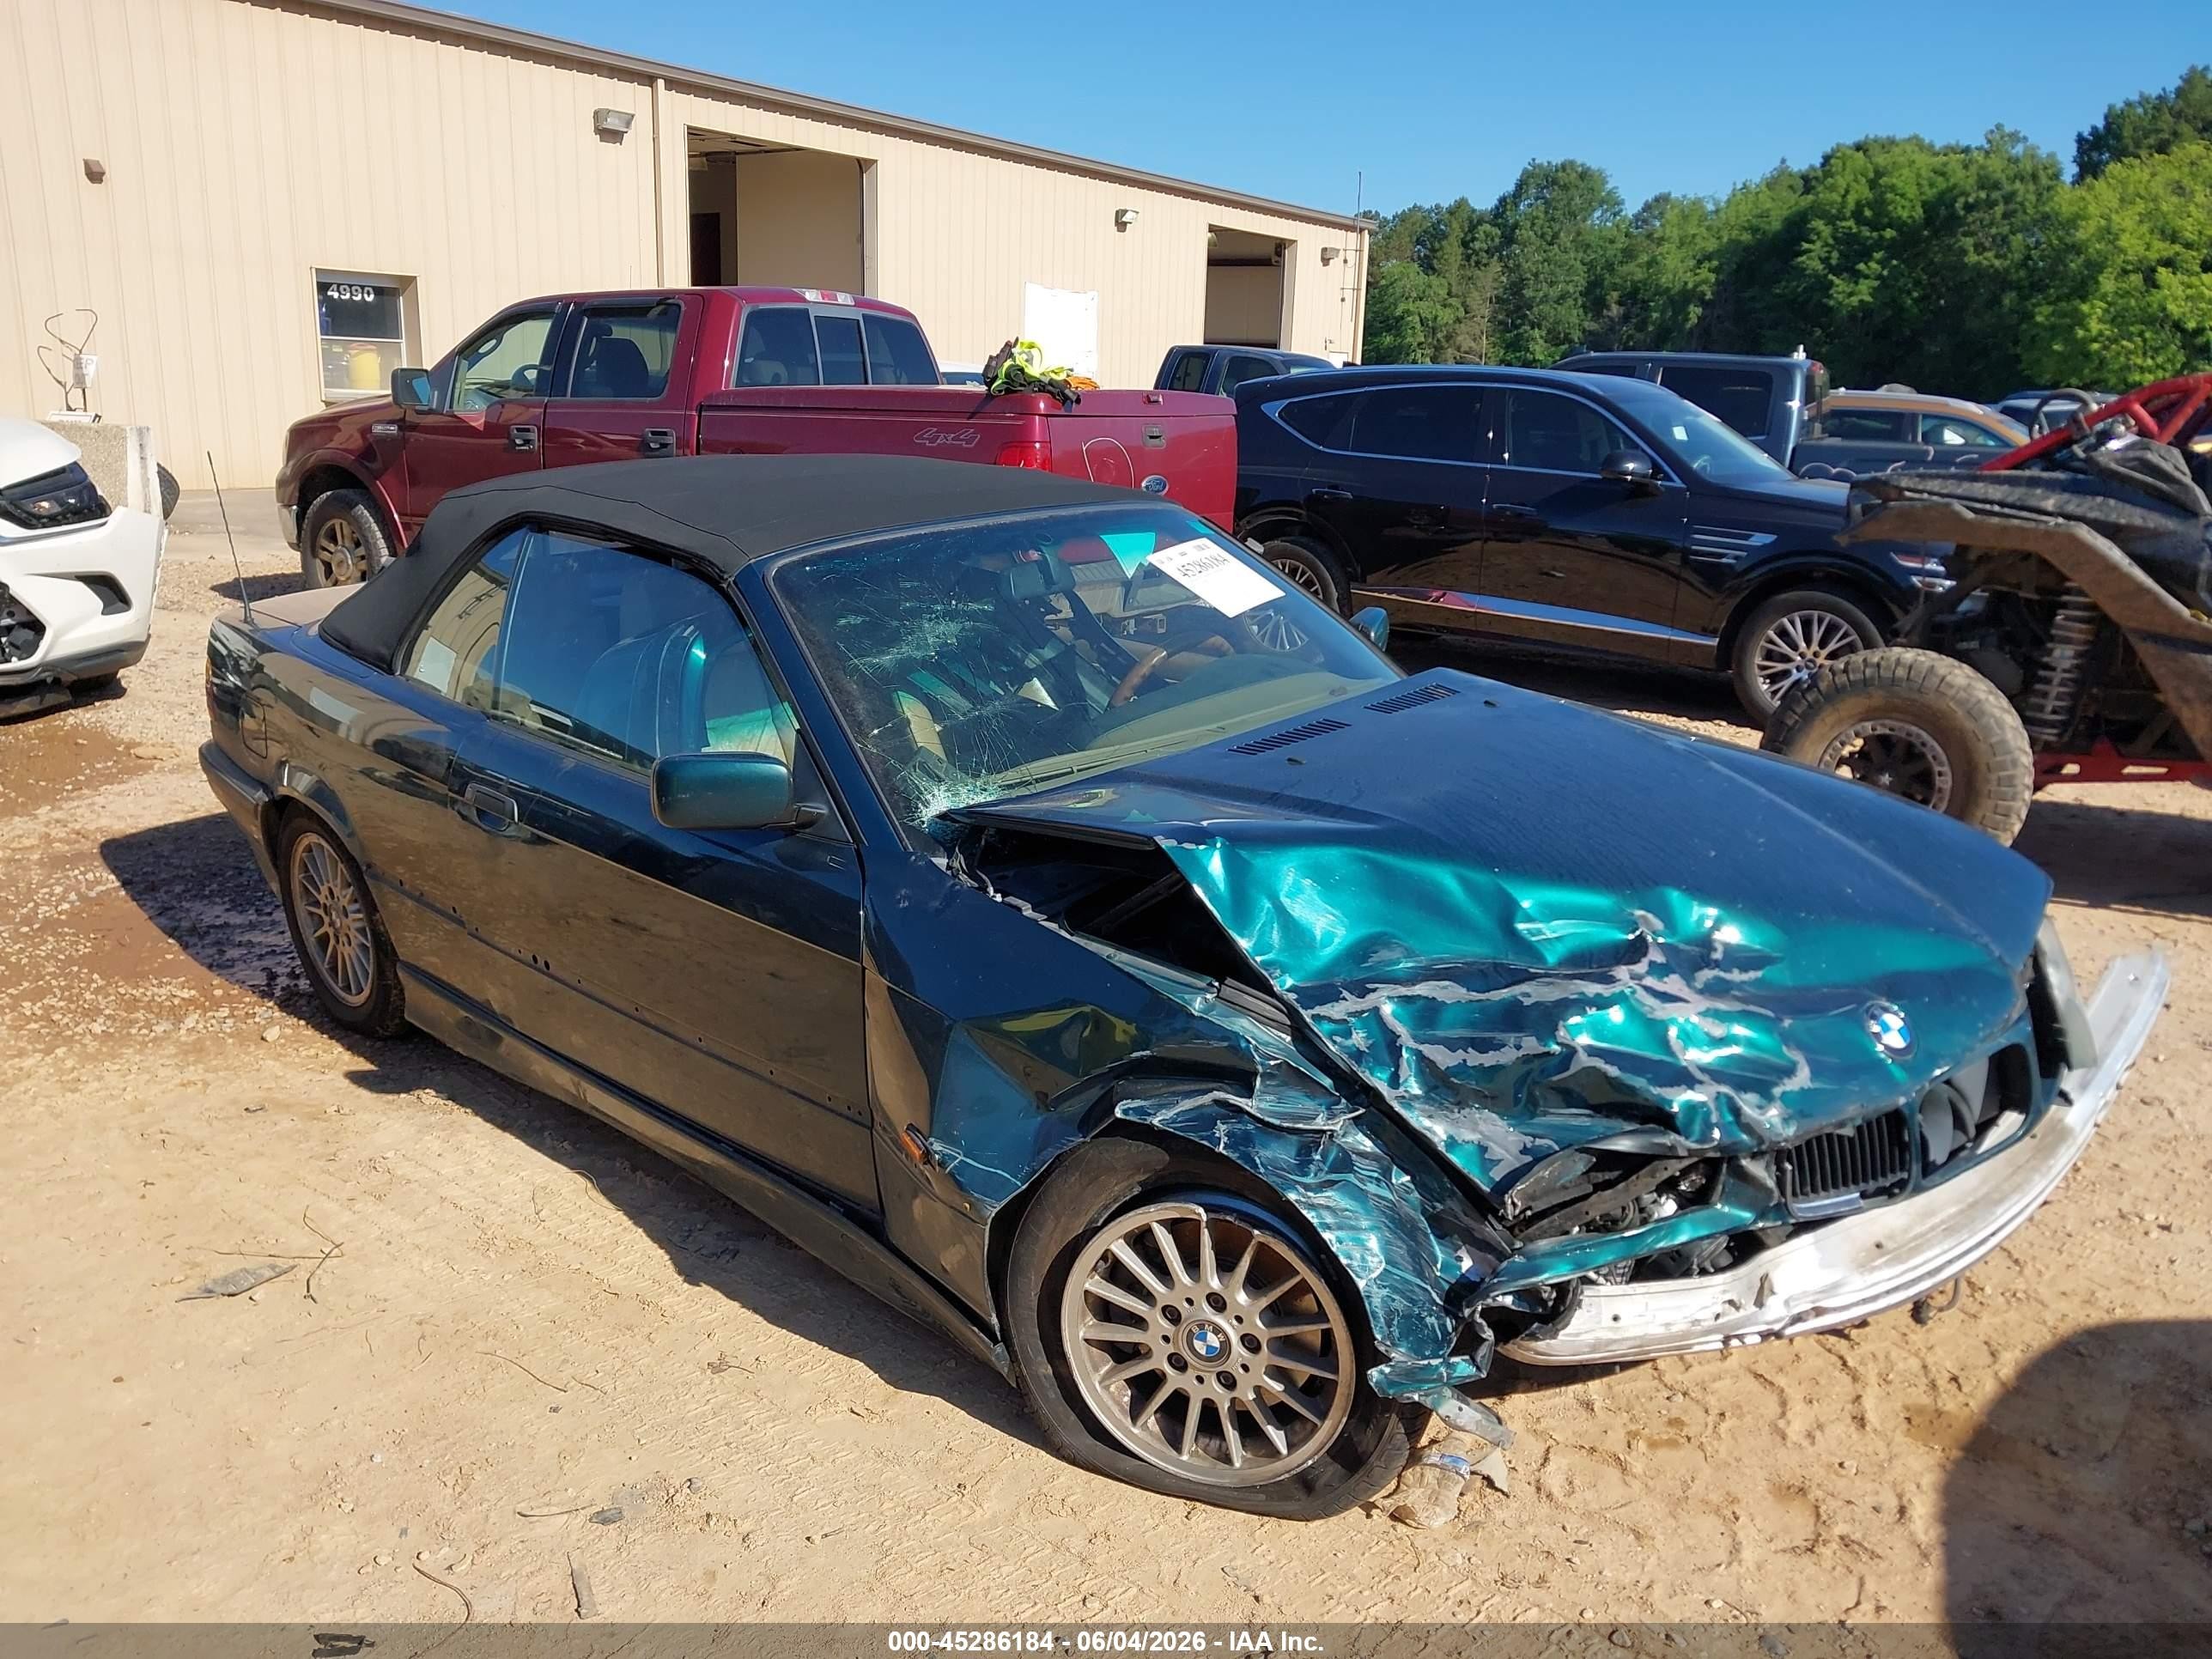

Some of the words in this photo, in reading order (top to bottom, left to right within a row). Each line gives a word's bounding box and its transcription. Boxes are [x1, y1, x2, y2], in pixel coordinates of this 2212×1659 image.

[326, 283, 374, 301] 4990
[914, 428, 980, 447] 4x4
[1176, 552, 1231, 579] 45286184
[1191, 1323, 1226, 1342] BMW
